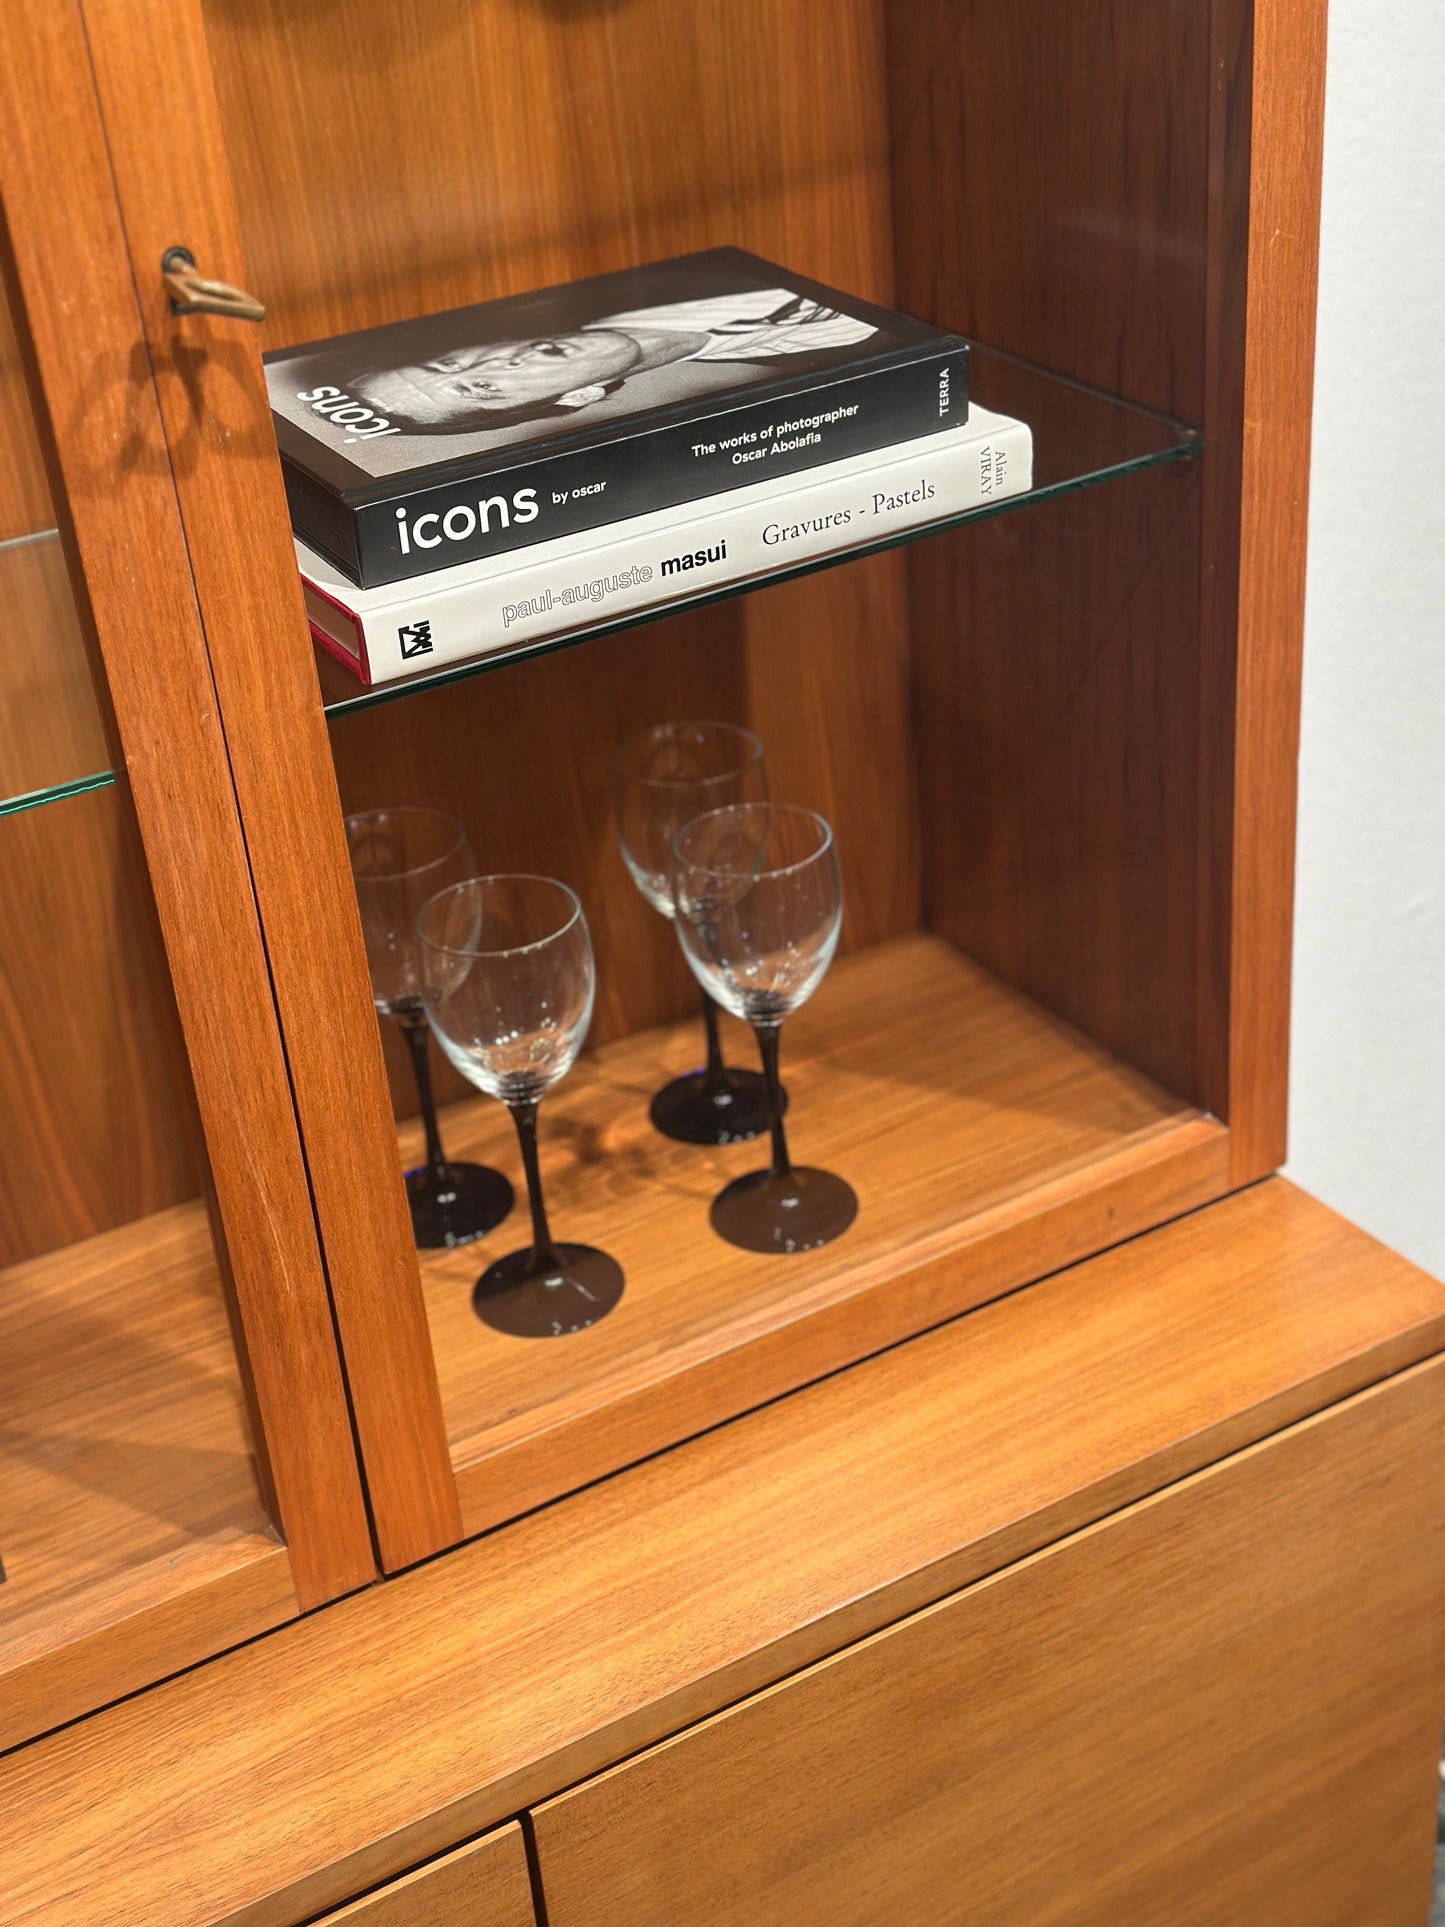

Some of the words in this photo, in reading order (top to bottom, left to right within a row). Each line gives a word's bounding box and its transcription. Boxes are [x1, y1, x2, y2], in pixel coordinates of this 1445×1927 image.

[297, 387, 401, 443] icons
[939, 367, 950, 417] TERRA
[692, 443, 716, 457] The
[719, 432, 757, 450] works
[759, 426, 774, 439] of
[776, 404, 859, 438] photographer
[732, 447, 768, 465] Oscar
[770, 432, 821, 456] Abolafia
[980, 446, 992, 496] VIRAY
[995, 450, 1006, 486] Alain
[395, 488, 539, 554] icons
[552, 491, 568, 505] by
[571, 480, 607, 499] oscar
[762, 508, 851, 546] Gravures
[872, 479, 936, 516] Pastels
[501, 564, 653, 627] paul-auguste
[660, 539, 728, 577] masui
